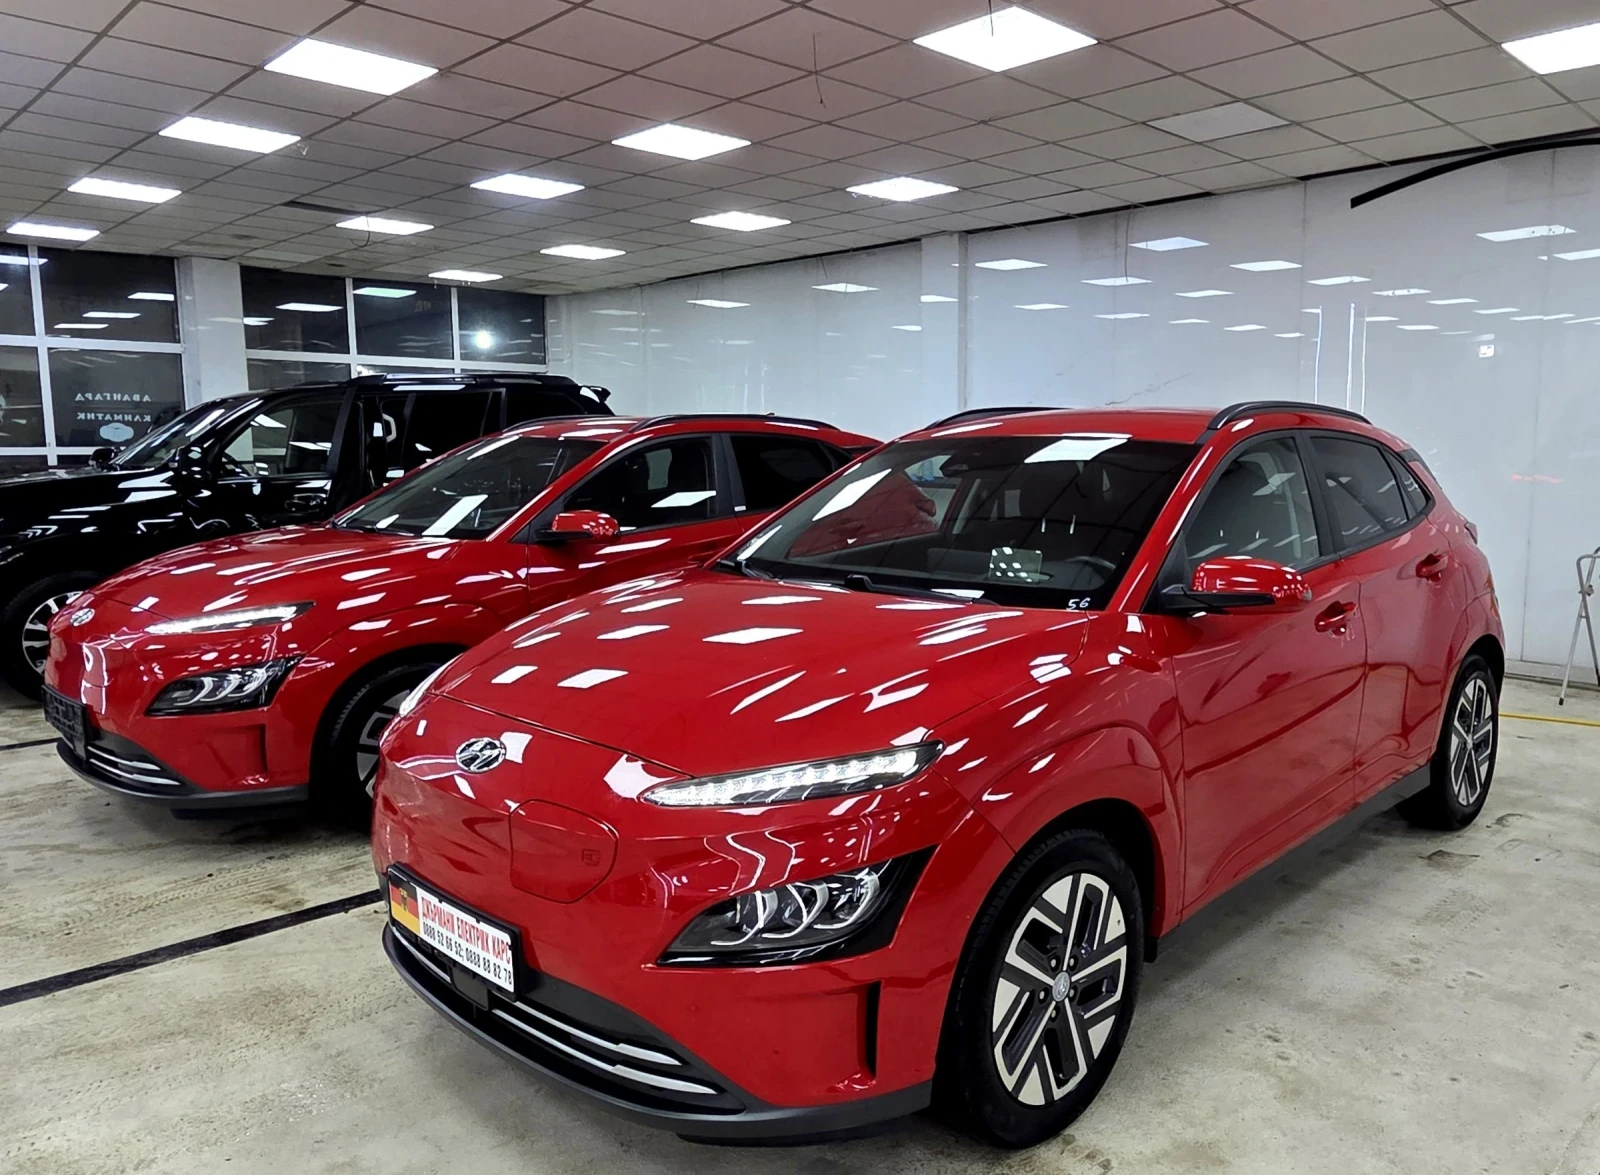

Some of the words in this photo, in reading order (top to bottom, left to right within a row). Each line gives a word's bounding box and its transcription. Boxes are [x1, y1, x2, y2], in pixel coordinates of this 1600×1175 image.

[1066, 597, 1091, 610] 56
[423, 921, 436, 941] 0888
[436, 930, 444, 946] 52
[445, 935, 453, 951] 66
[465, 948, 481, 968] 0888
[482, 957, 491, 974] 88
[493, 963, 502, 979] 82
[503, 968, 512, 985] 78
[456, 916, 491, 954] ЕЛЕКТРИК
[491, 934, 511, 965] КАРС
